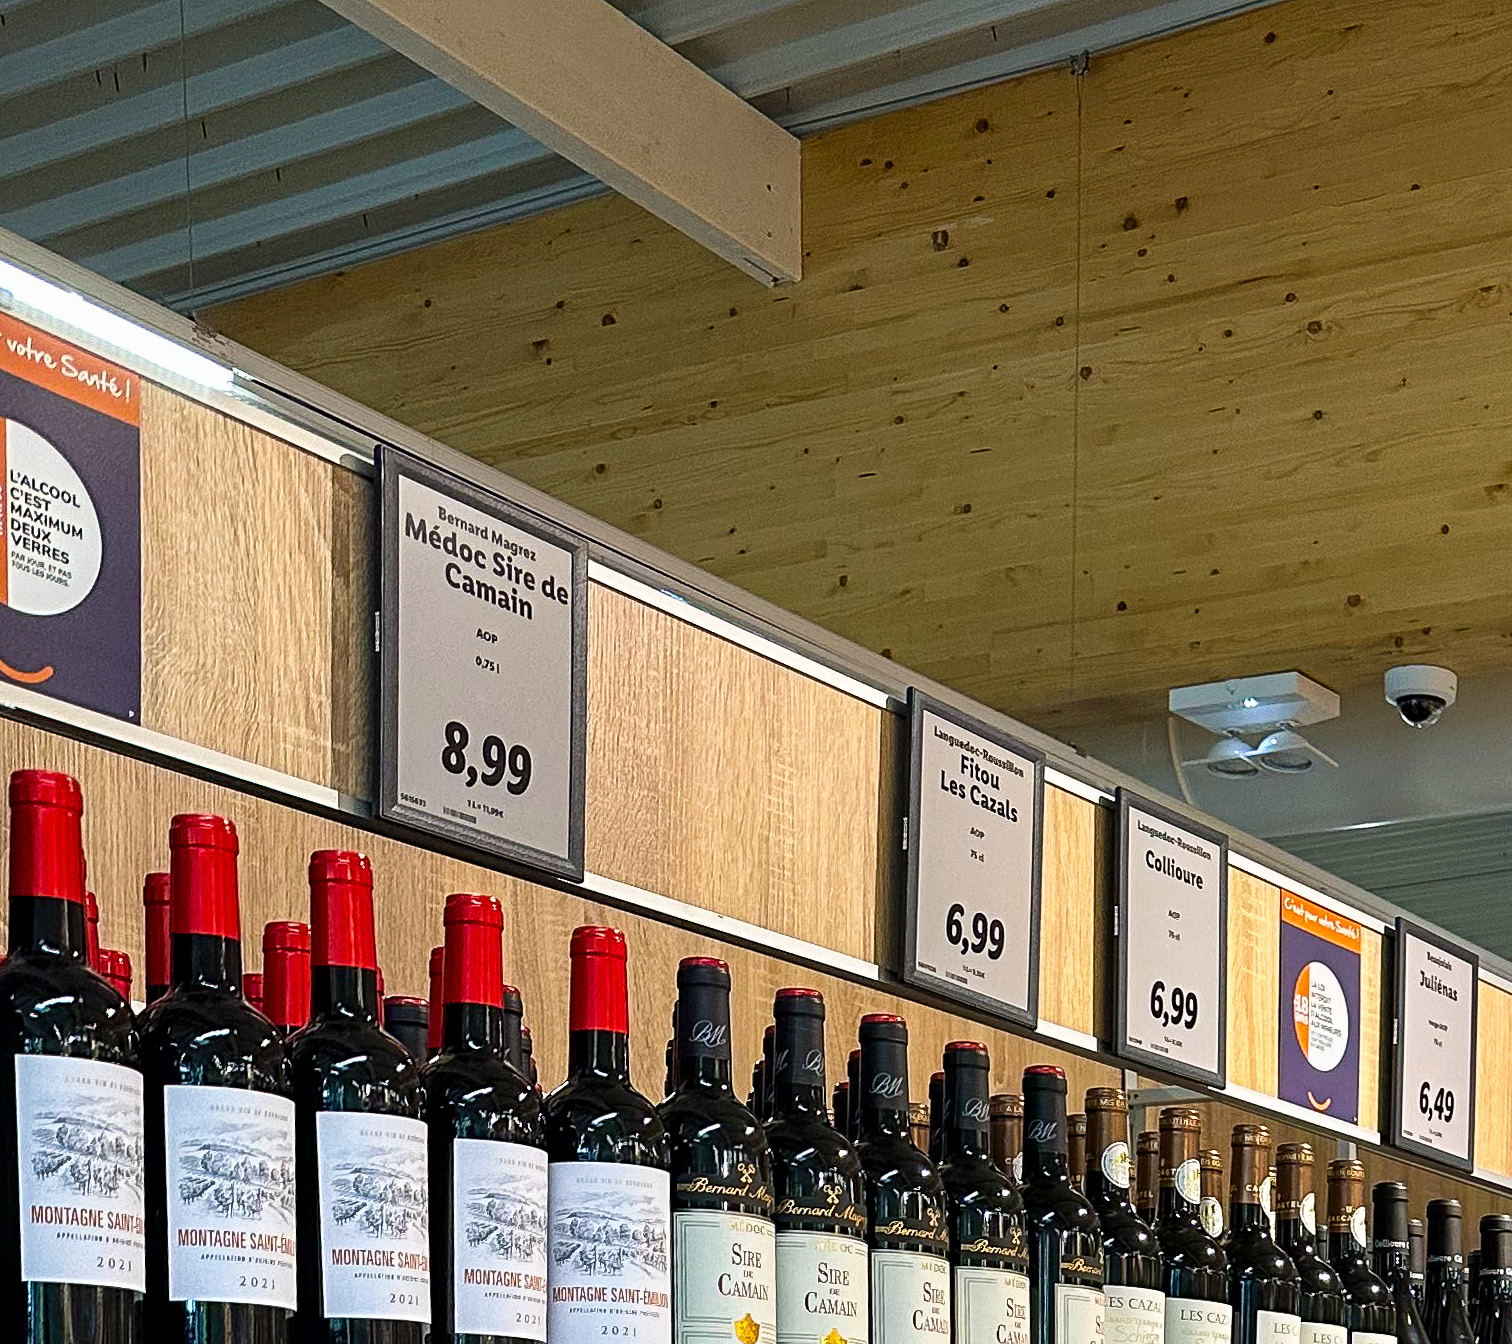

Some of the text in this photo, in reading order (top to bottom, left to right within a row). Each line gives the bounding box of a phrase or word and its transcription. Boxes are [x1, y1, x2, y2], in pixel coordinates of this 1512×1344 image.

[7, 336, 56, 369] votre
[10, 469, 81, 508] L'ALCOOL
[10, 487, 51, 511] C'EST
[10, 502, 83, 540] MAXIMUM
[10, 518, 51, 543] DEUX
[438, 506, 536, 561] Bernard Magrez
[11, 531, 69, 564] VERRES
[405, 513, 569, 604] Médoc Sire de
[445, 563, 533, 620] Camain
[476, 628, 497, 644] AOP
[442, 721, 532, 795] 8,99
[961, 754, 1000, 790] Fitou
[941, 770, 1018, 822] Les Cazals
[1145, 850, 1203, 889] Collioure
[946, 903, 1005, 960] 6,99
[1420, 970, 1458, 1001] Juliénas
[1151, 980, 1197, 1029] 6,99
[1419, 1082, 1454, 1122] 6,49
[689, 1176, 747, 1197] Bernard
[778, 1199, 835, 1218] Bernard
[178, 1227, 247, 1249] MONTAGNE
[96, 1255, 133, 1272] 2021
[331, 1247, 395, 1268] MONTAGNE
[731, 1243, 761, 1269] SIRE
[239, 1276, 277, 1291] 2021
[463, 1267, 522, 1289] MONTAGNE
[817, 1262, 849, 1286] SIRE
[389, 1292, 421, 1307] 2021
[552, 1287, 609, 1306] MONTAGNE
[718, 1273, 769, 1302] CAMAIN
[804, 1291, 858, 1317] CAMAIN
[515, 1312, 542, 1325] 2021
[601, 1324, 638, 1338] 2021
